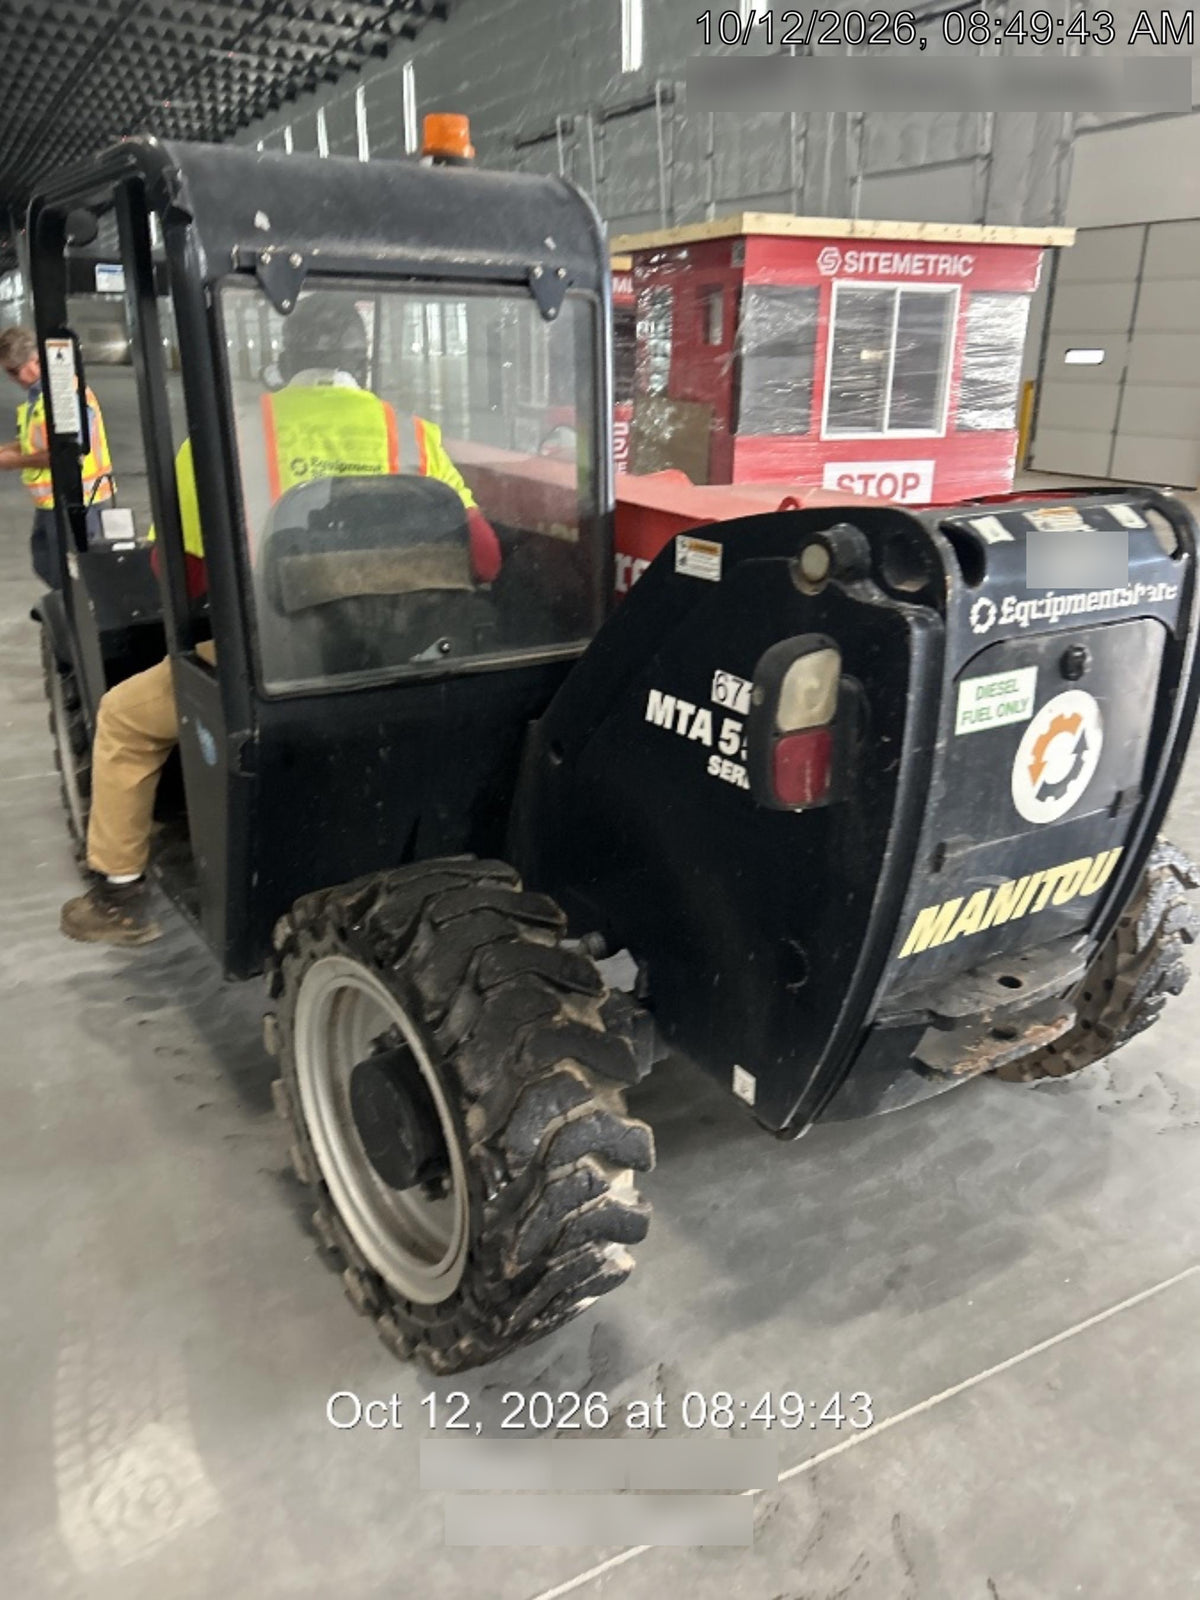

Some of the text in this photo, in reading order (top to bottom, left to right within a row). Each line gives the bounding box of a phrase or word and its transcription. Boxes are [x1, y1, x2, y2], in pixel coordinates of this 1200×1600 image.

[843, 250, 976, 277] SITEMETRIC
[836, 472, 920, 500] STOP
[975, 678, 1019, 701] DIESEL
[645, 688, 748, 761] MTA 5
[960, 697, 1030, 727] FUEL ONLY
[897, 846, 1125, 959] MANITOU
